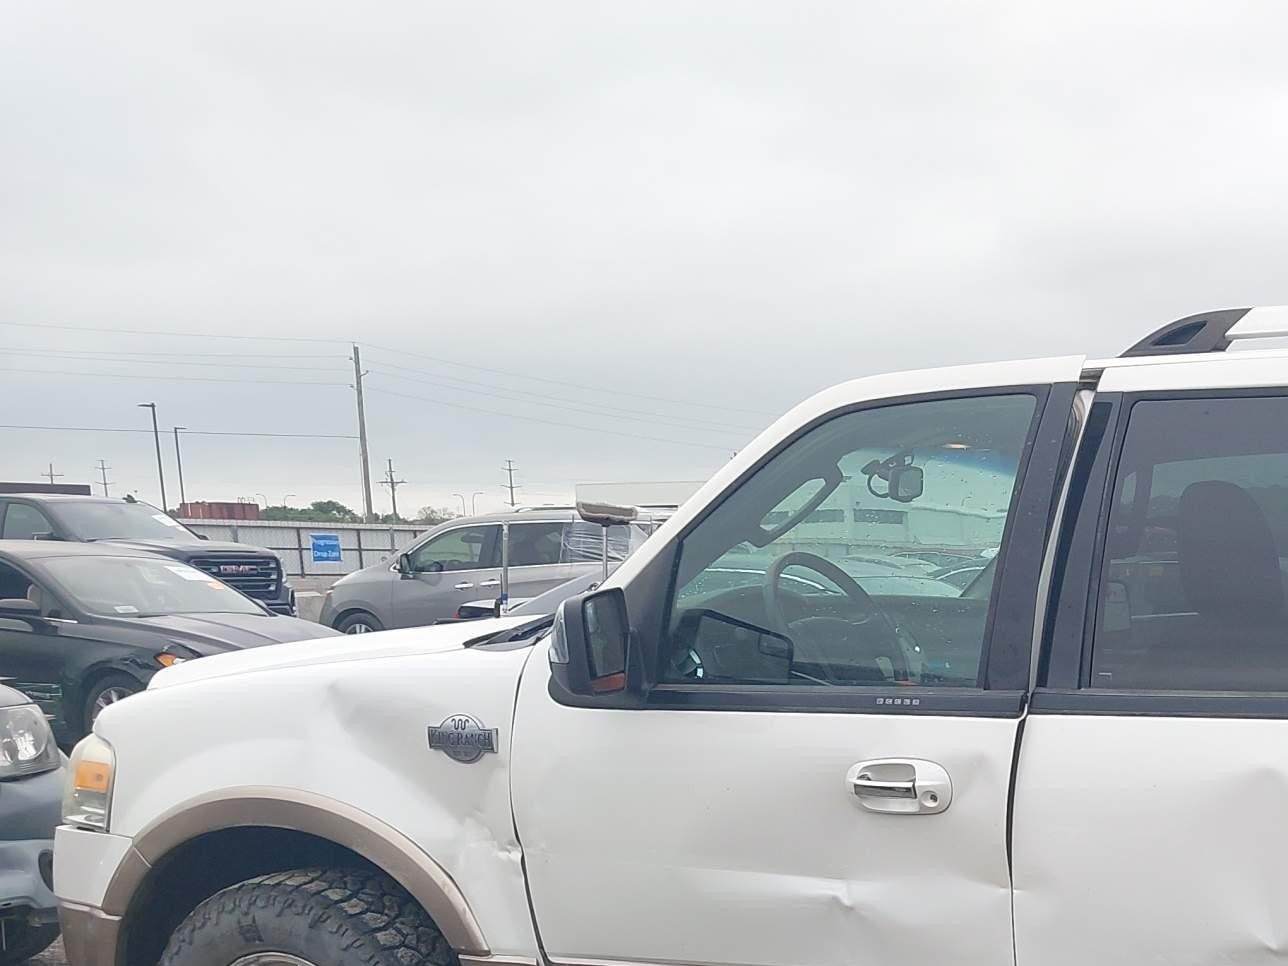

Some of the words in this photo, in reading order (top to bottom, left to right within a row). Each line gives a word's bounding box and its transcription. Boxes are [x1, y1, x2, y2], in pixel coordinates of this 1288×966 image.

[220, 565, 257, 574] GMC
[431, 729, 456, 747] KING
[456, 731, 491, 747] RANCH
